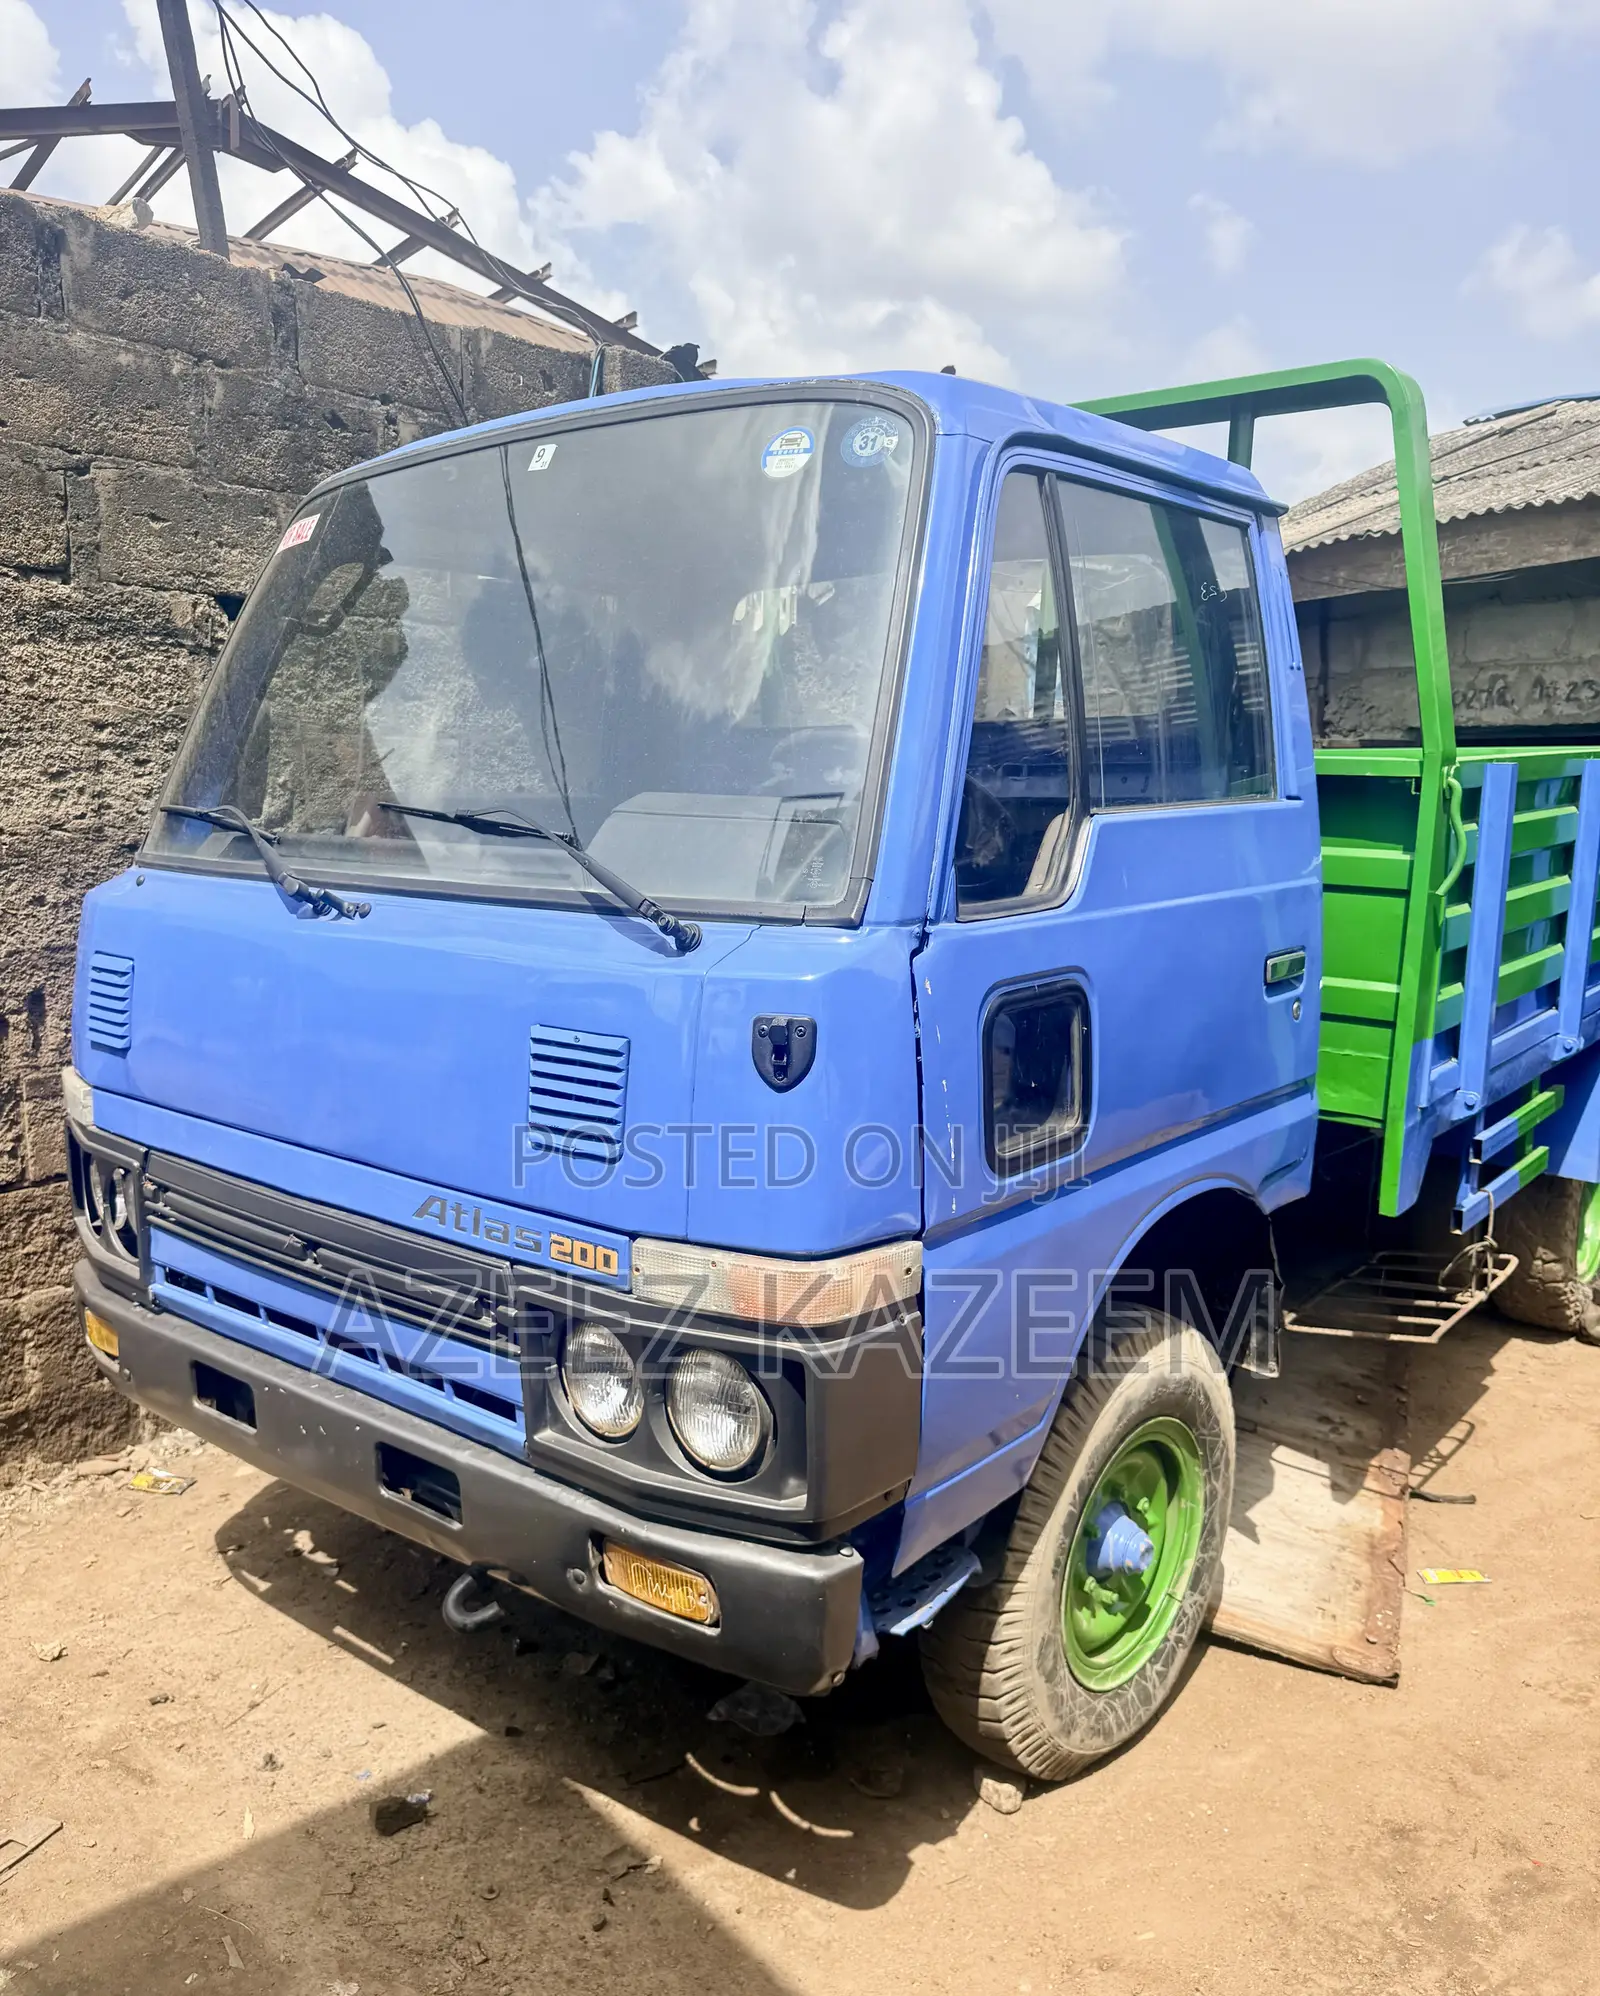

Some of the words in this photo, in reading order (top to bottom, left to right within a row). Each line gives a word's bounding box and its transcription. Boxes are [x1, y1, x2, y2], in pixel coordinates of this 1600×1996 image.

[858, 435, 879, 451] 31
[535, 447, 546, 463] 9
[411, 1194, 543, 1255] Atlas
[548, 1230, 620, 1277] 200
